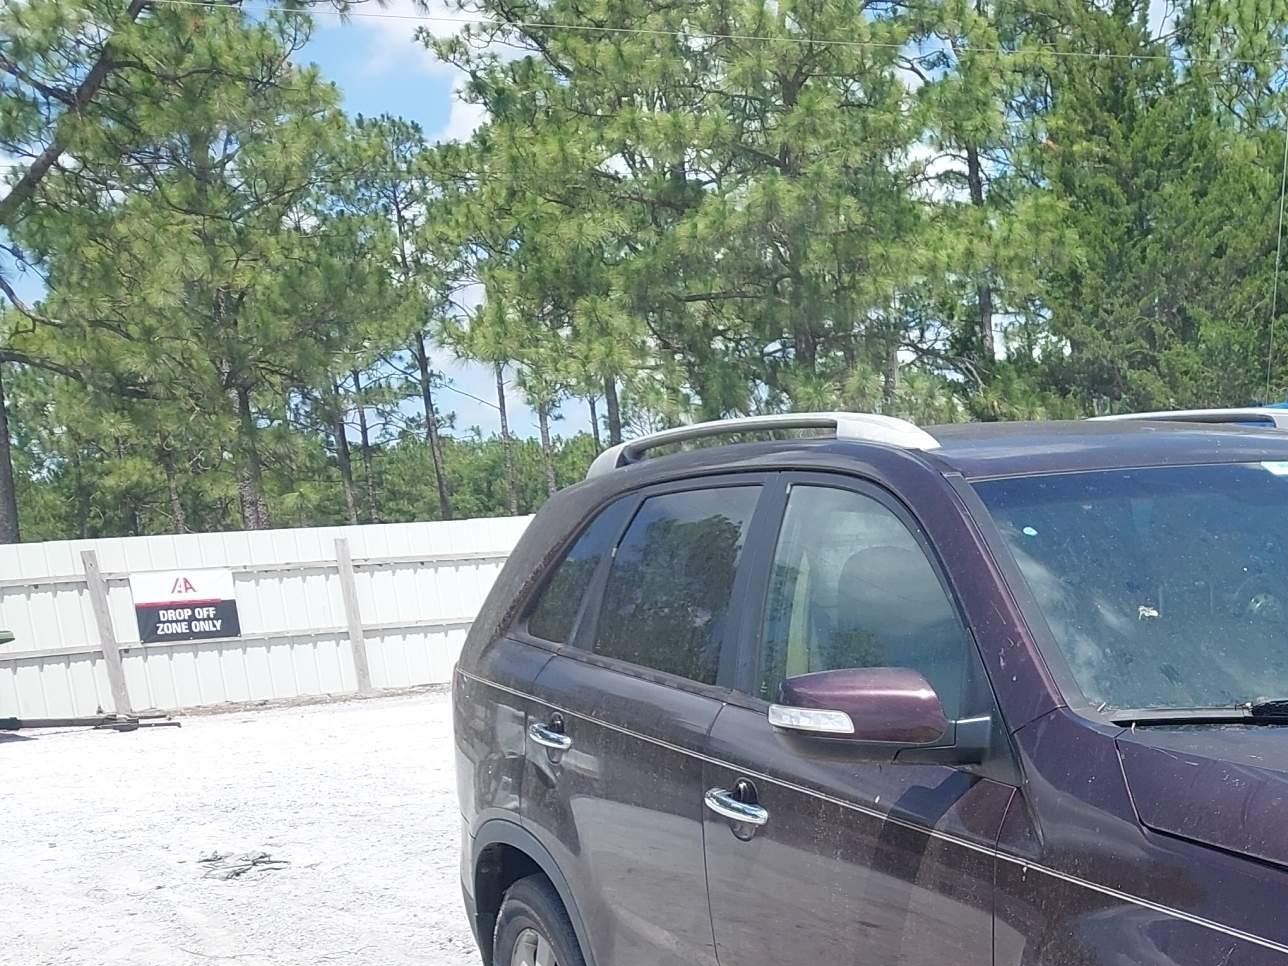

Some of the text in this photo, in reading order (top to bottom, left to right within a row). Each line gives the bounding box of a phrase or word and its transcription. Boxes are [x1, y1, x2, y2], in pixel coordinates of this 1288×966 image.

[159, 607, 216, 621] DROP OFF
[156, 620, 222, 634] ZONE ONLY
